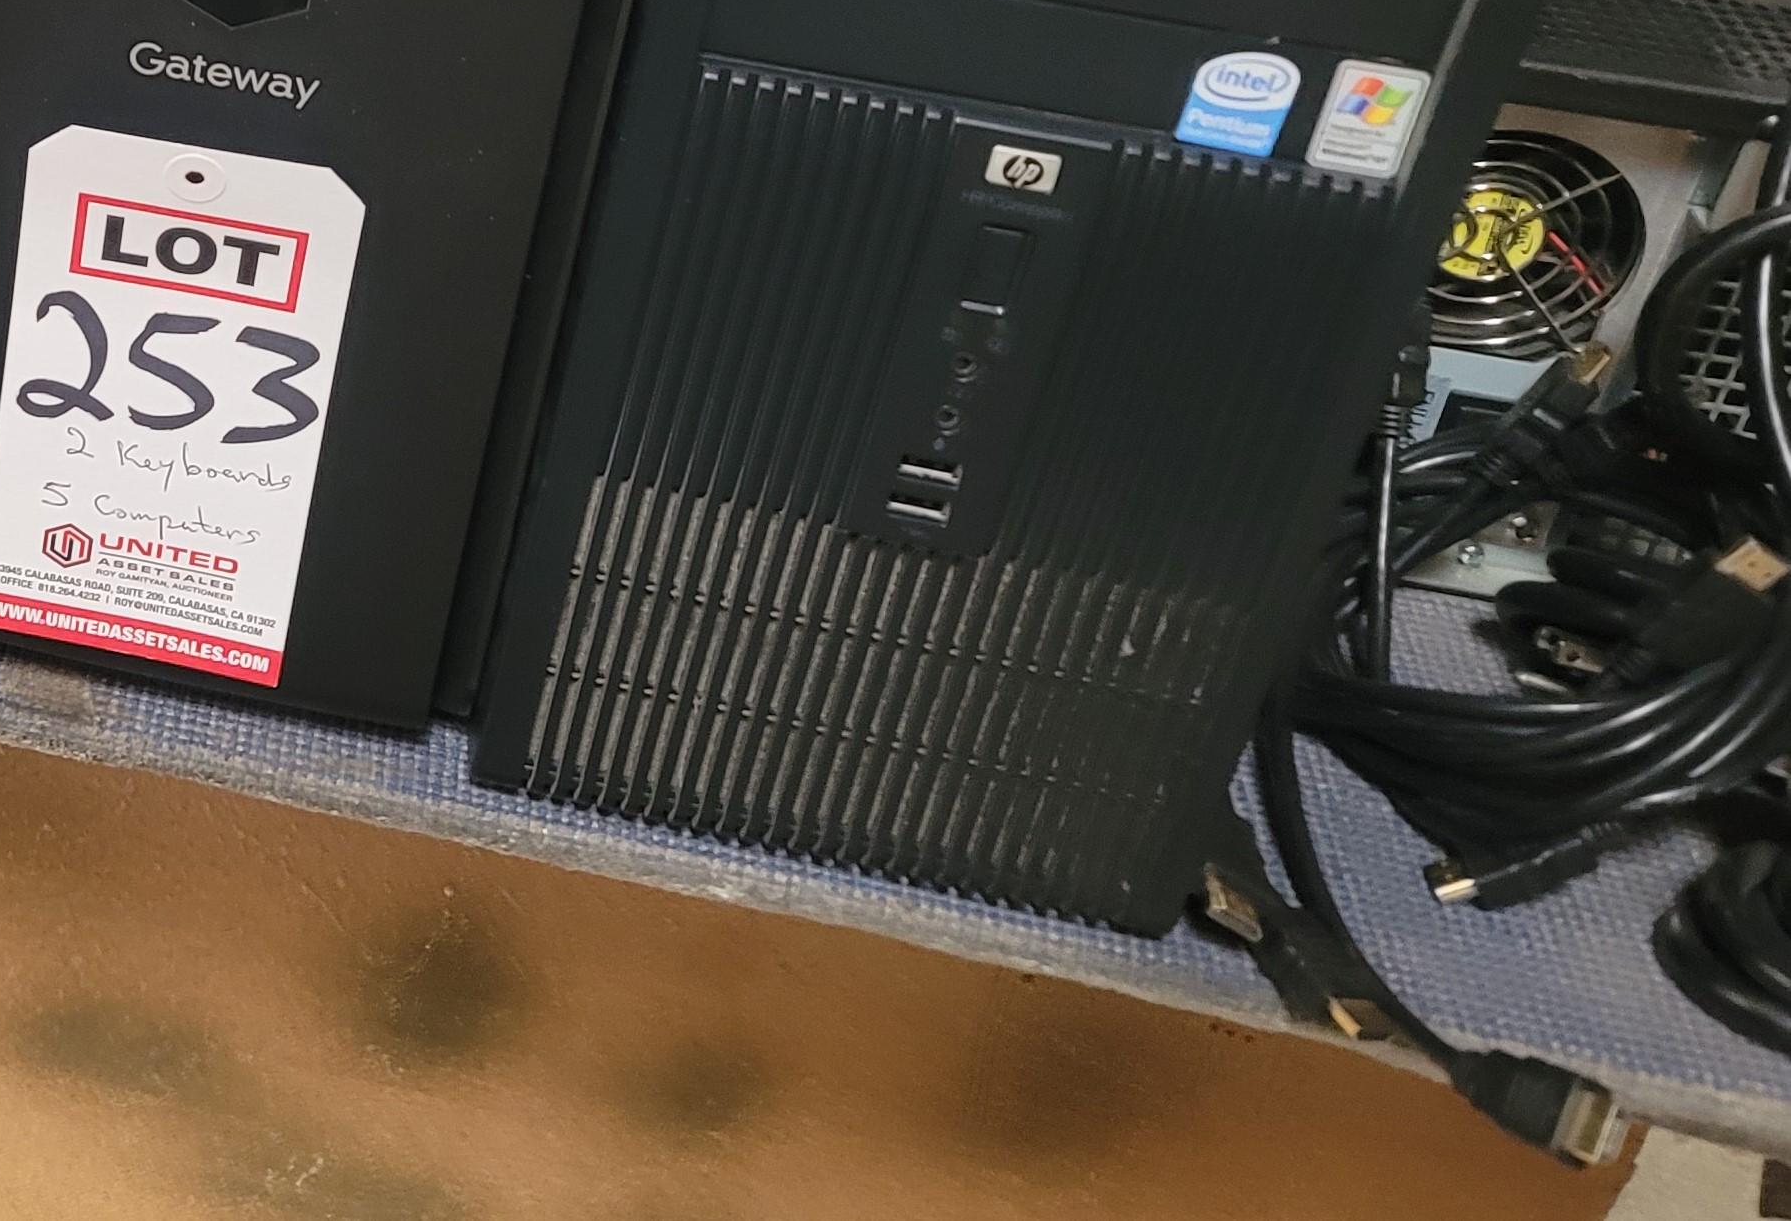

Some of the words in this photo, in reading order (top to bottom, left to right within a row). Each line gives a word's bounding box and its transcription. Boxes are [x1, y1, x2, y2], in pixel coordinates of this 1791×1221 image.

[128, 41, 320, 110] Gateway
[1216, 63, 1277, 92] intel
[1005, 154, 1042, 190] hp
[101, 215, 280, 286] LOT
[16, 290, 320, 444] 253
[66, 427, 94, 458] 2
[118, 440, 292, 491] Keyboards
[41, 482, 72, 507] 5
[94, 493, 261, 544] Computers
[98, 557, 165, 577] ASSET
[169, 571, 235, 592] SALES
[99, 533, 239, 575] UNITED
[0, 576, 34, 590] OFFICE
[38, 582, 101, 603] 818.264.4232
[113, 597, 264, 637] ROY@UNITEDASSETSALES.COM
[24, 569, 82, 588] CALABASAS
[84, 581, 114, 595] ROAD,
[116, 585, 144, 599] SUITE
[146, 591, 166, 604] 209,
[168, 595, 228, 618] CALABASAS,
[230, 610, 244, 621] CA
[246, 613, 277, 628] 91302
[96, 568, 115, 578] ROY
[171, 583, 234, 603] AUCTIONEER
